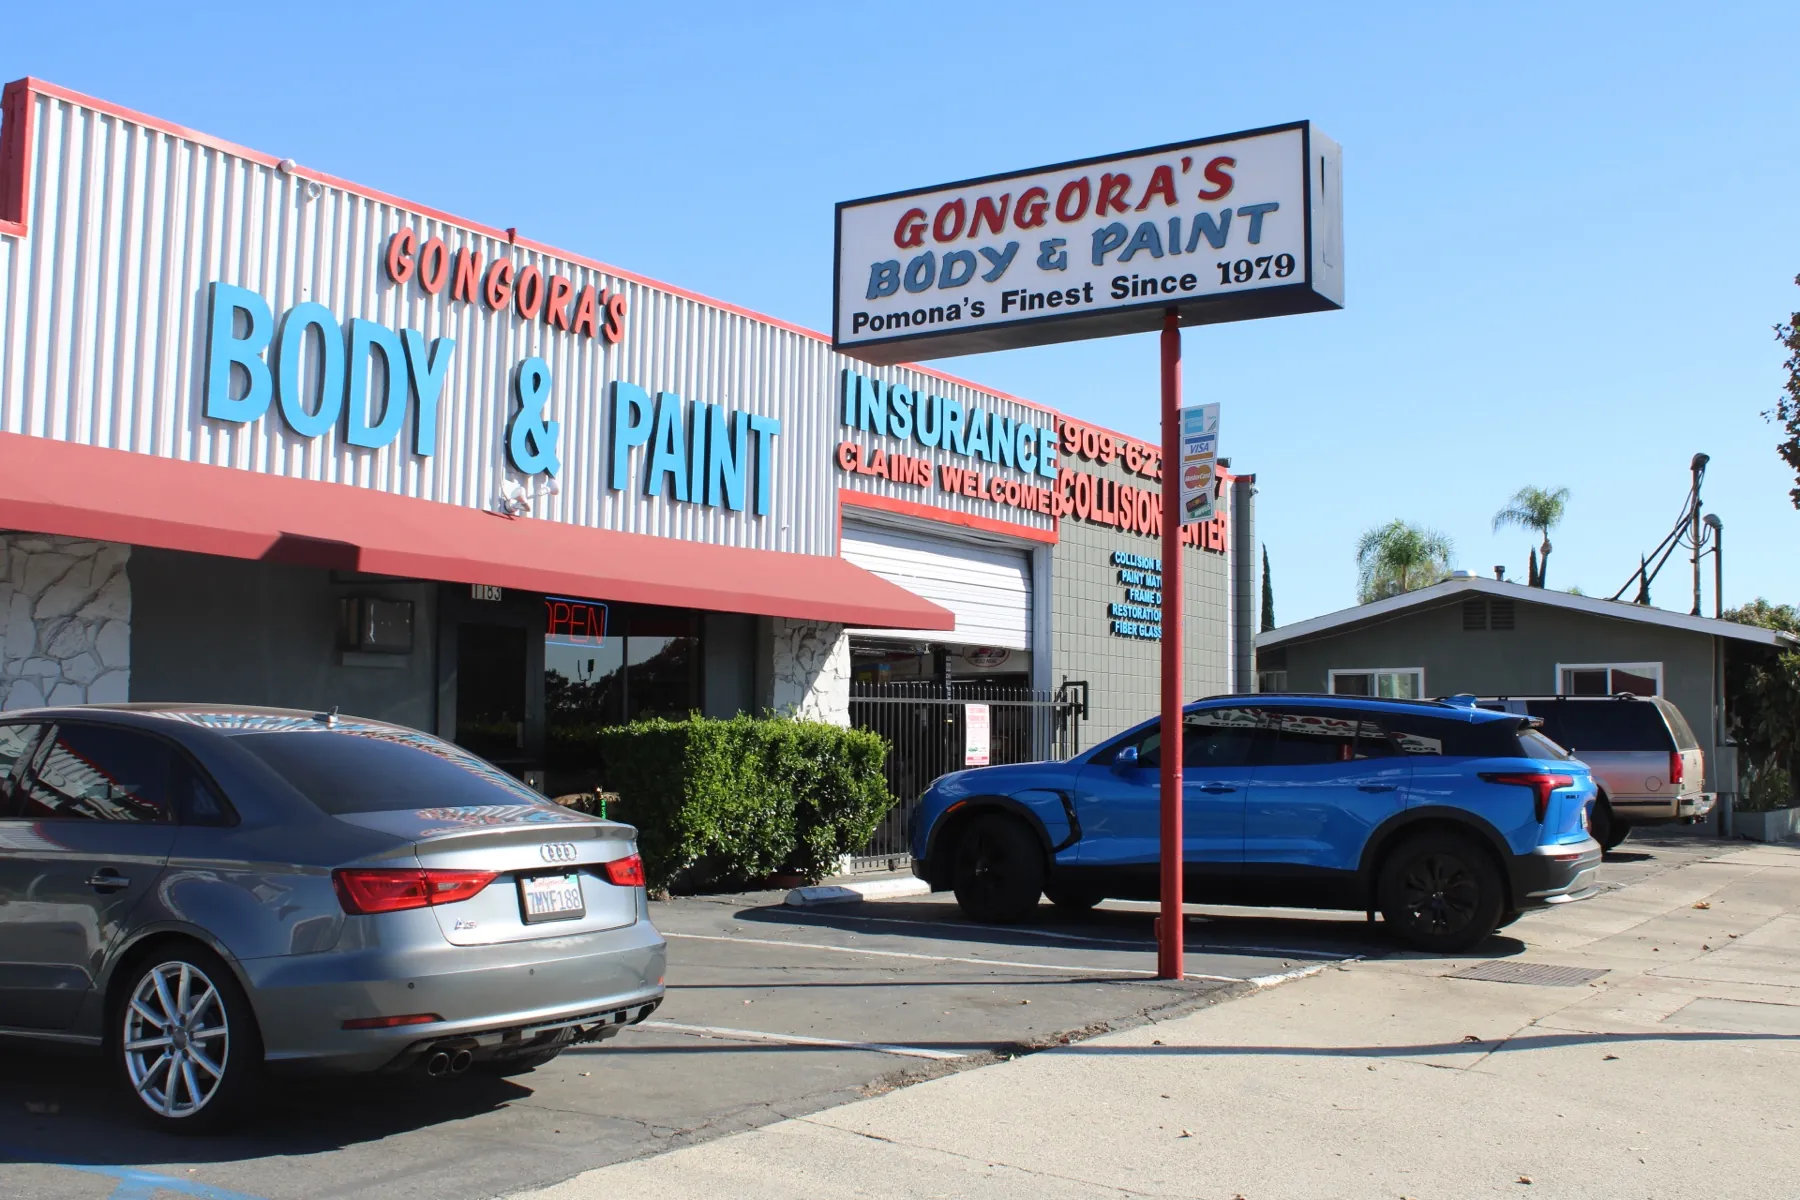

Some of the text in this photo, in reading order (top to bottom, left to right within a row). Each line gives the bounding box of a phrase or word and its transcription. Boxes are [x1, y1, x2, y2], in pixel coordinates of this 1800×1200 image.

[893, 156, 1237, 248] GONGORA'S
[386, 227, 627, 344] GONGORA'S
[865, 202, 1280, 300] BODY & PAINT
[852, 253, 1296, 334] Pomona's Finest Since 1979
[203, 281, 781, 516] BODY & PAINT
[841, 368, 1058, 479] INSURANCE
[837, 441, 1063, 517] CLAIMS WELCOMED
[1189, 442, 1210, 454] VISA
[1059, 467, 1162, 537] COLLISION
[1113, 550, 1154, 570] COLLISION
[1121, 569, 1145, 585] PAINT
[1129, 588, 1155, 604] FRAME
[1115, 621, 1138, 635] FIBER
[527, 888, 581, 914] 7MYF188
